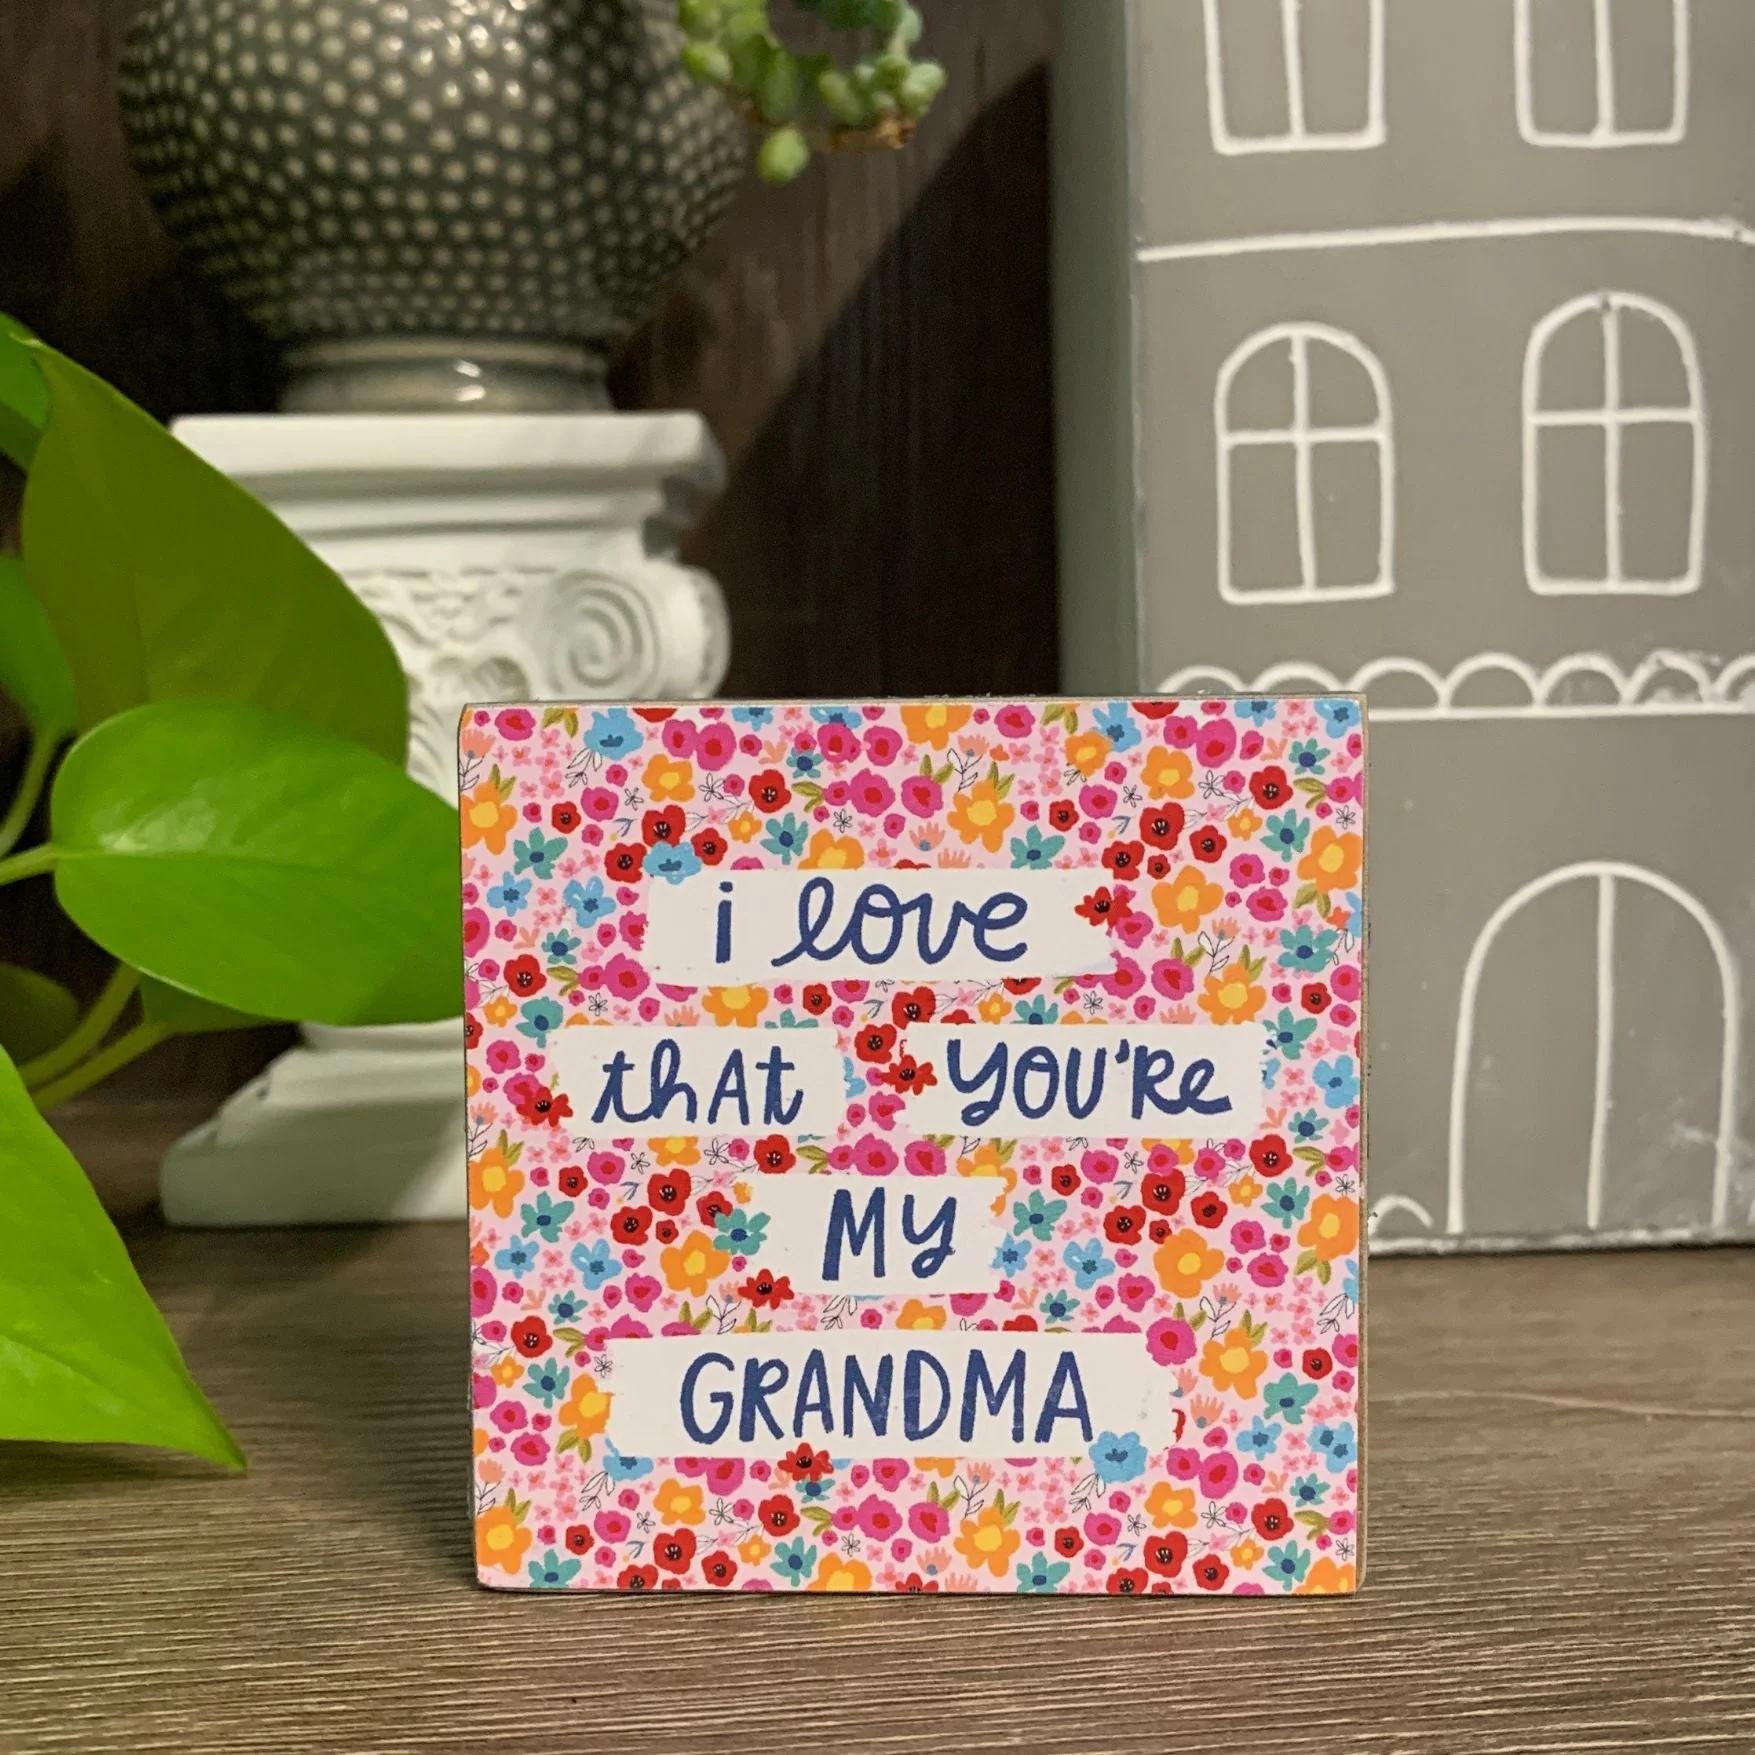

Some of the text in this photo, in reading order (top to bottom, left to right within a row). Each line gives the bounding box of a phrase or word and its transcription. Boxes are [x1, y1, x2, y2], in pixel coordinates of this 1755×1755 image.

[715, 877, 1028, 967] i love
[680, 1349, 1092, 1444] GRANDMA
